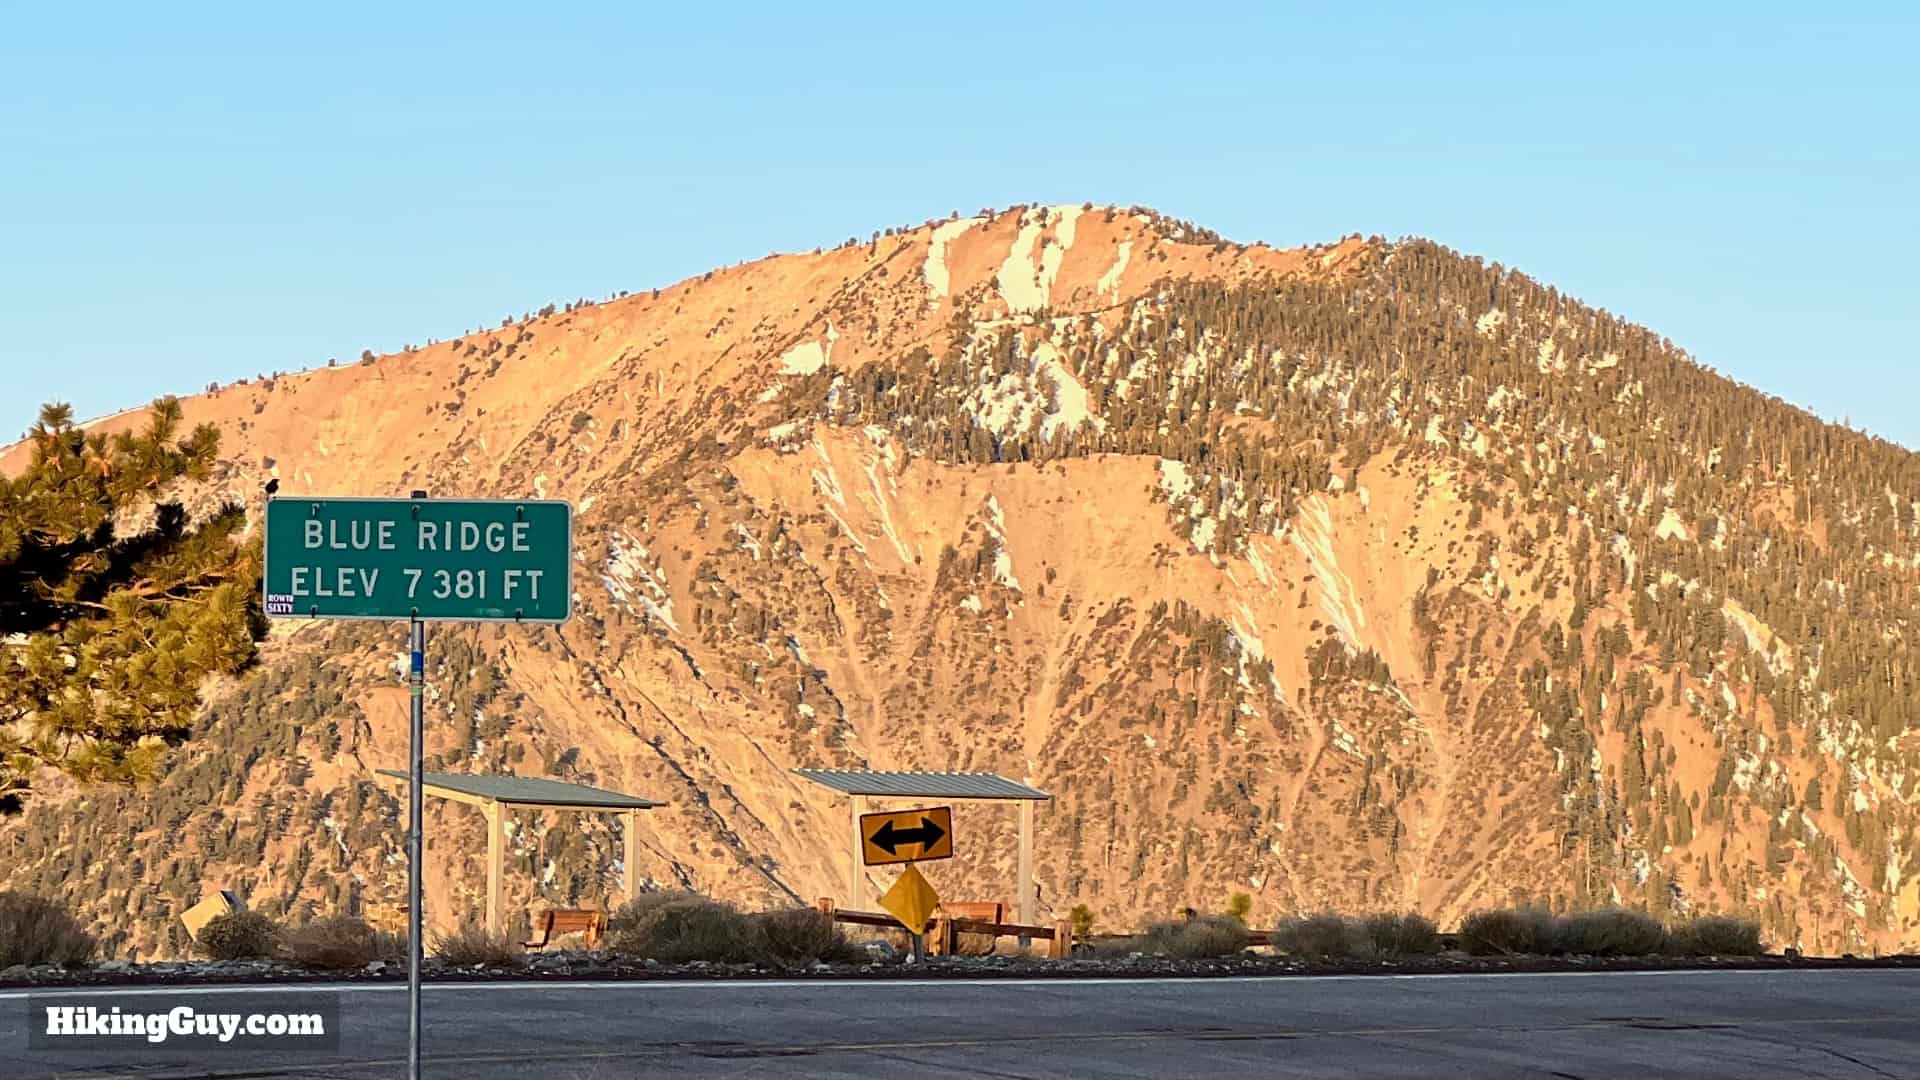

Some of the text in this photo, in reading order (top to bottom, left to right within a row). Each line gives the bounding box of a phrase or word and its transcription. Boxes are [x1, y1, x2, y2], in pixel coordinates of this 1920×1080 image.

[304, 519, 530, 552] BLUE RIDGE
[291, 567, 379, 597] ELEV
[504, 570, 543, 600] FT
[267, 602, 293, 613] SIXTY
